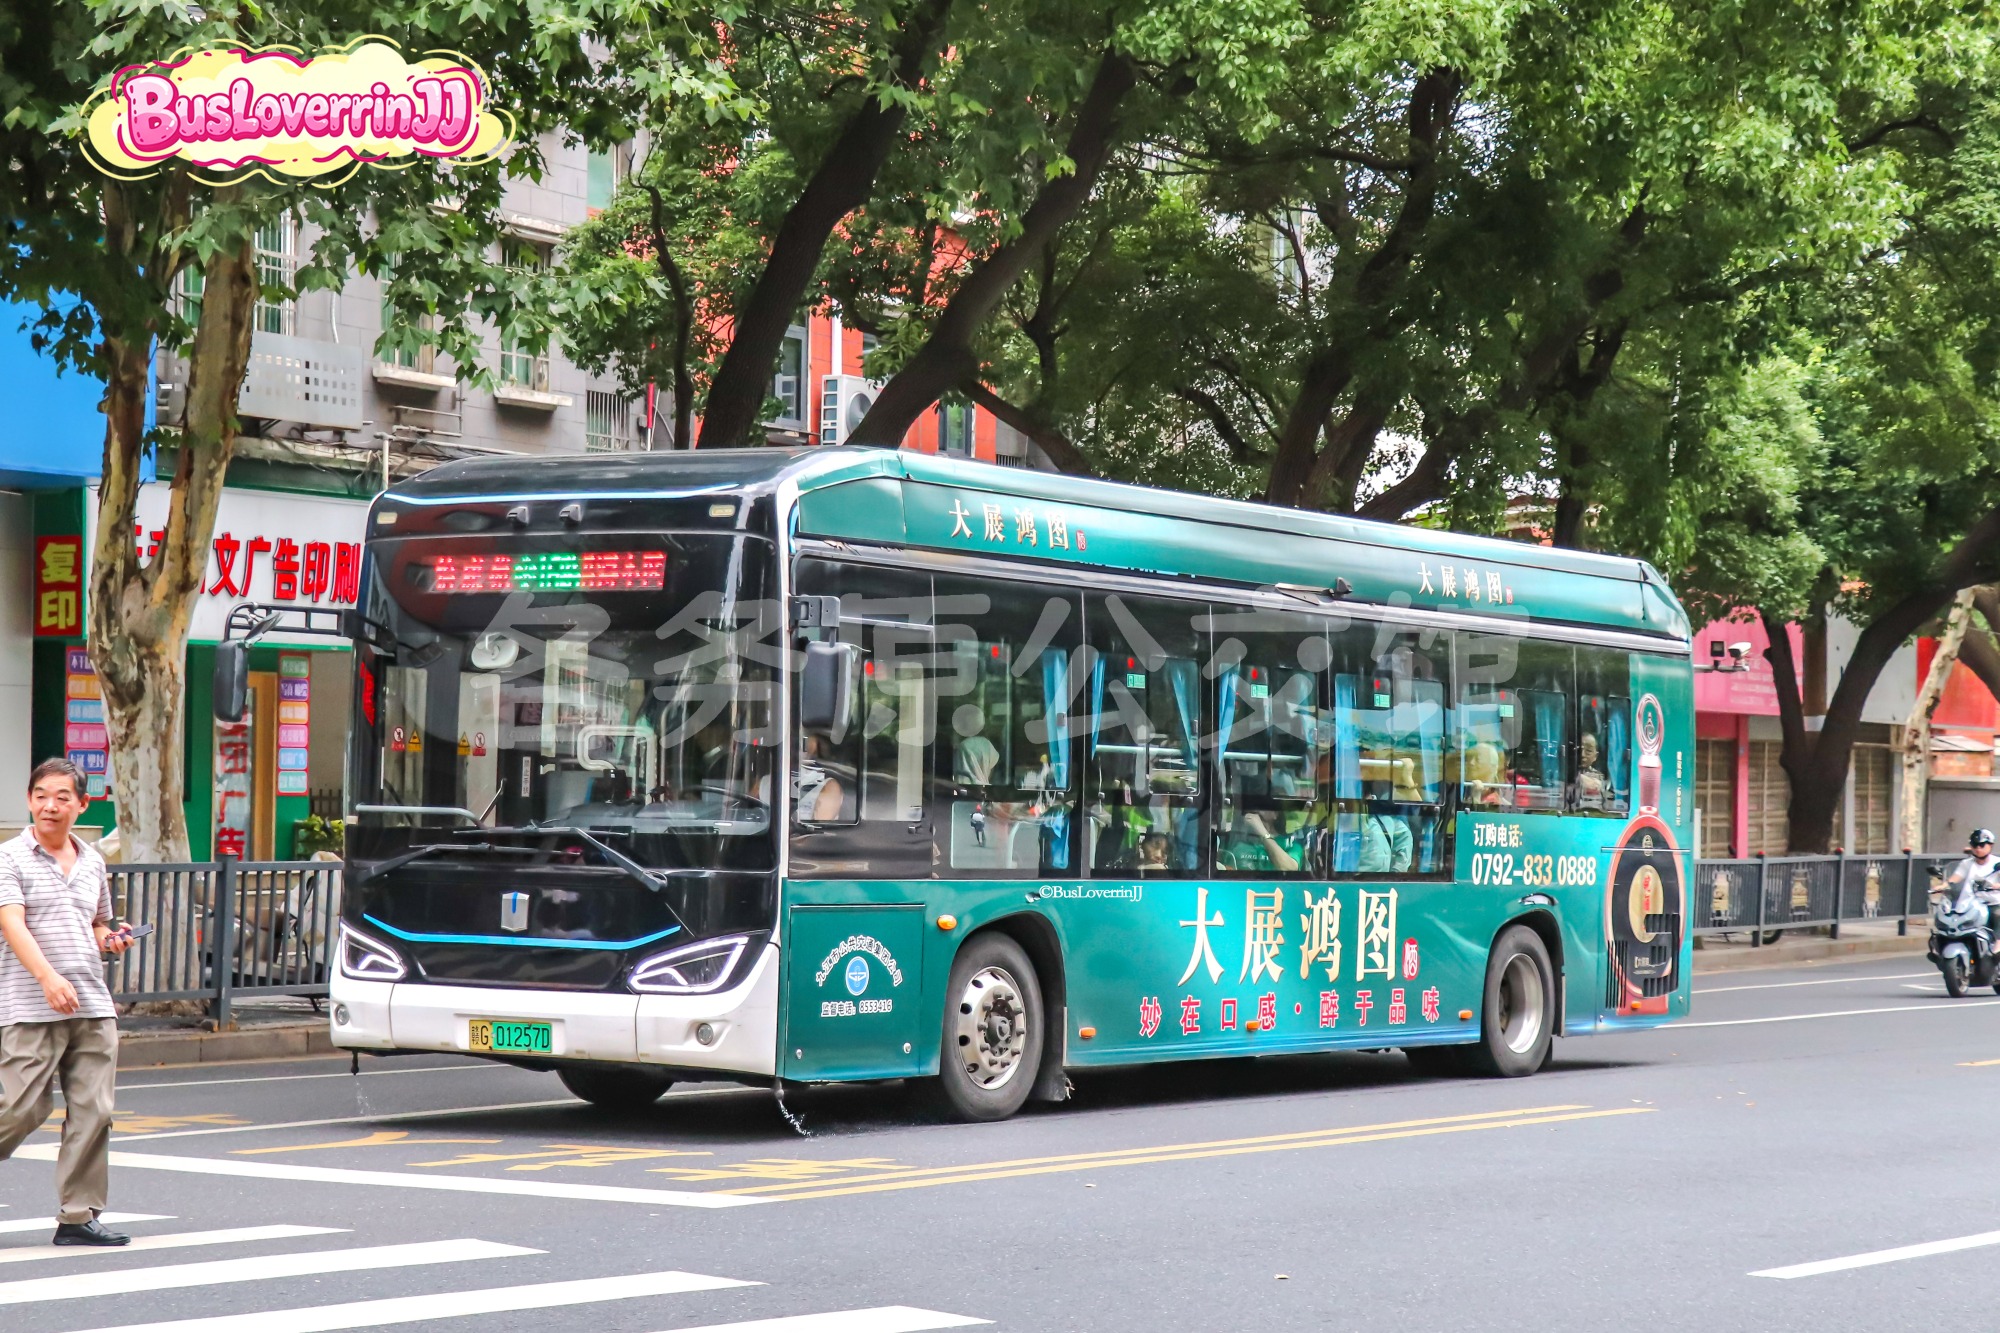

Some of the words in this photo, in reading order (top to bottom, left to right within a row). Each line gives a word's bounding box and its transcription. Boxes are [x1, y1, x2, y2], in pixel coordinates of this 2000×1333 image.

[949, 498, 1069, 551] 大展鸿图
[41, 542, 77, 630] 复印
[135, 523, 361, 604] 文广告印刷
[1417, 561, 1503, 605] 大展鸿图
[1473, 823, 1523, 848] 订购电话:
[1471, 852, 1553, 886] 0792-833
[1557, 854, 1597, 886] 0888
[1177, 886, 1398, 987] 大展鸿图
[859, 999, 893, 1014] 8553416
